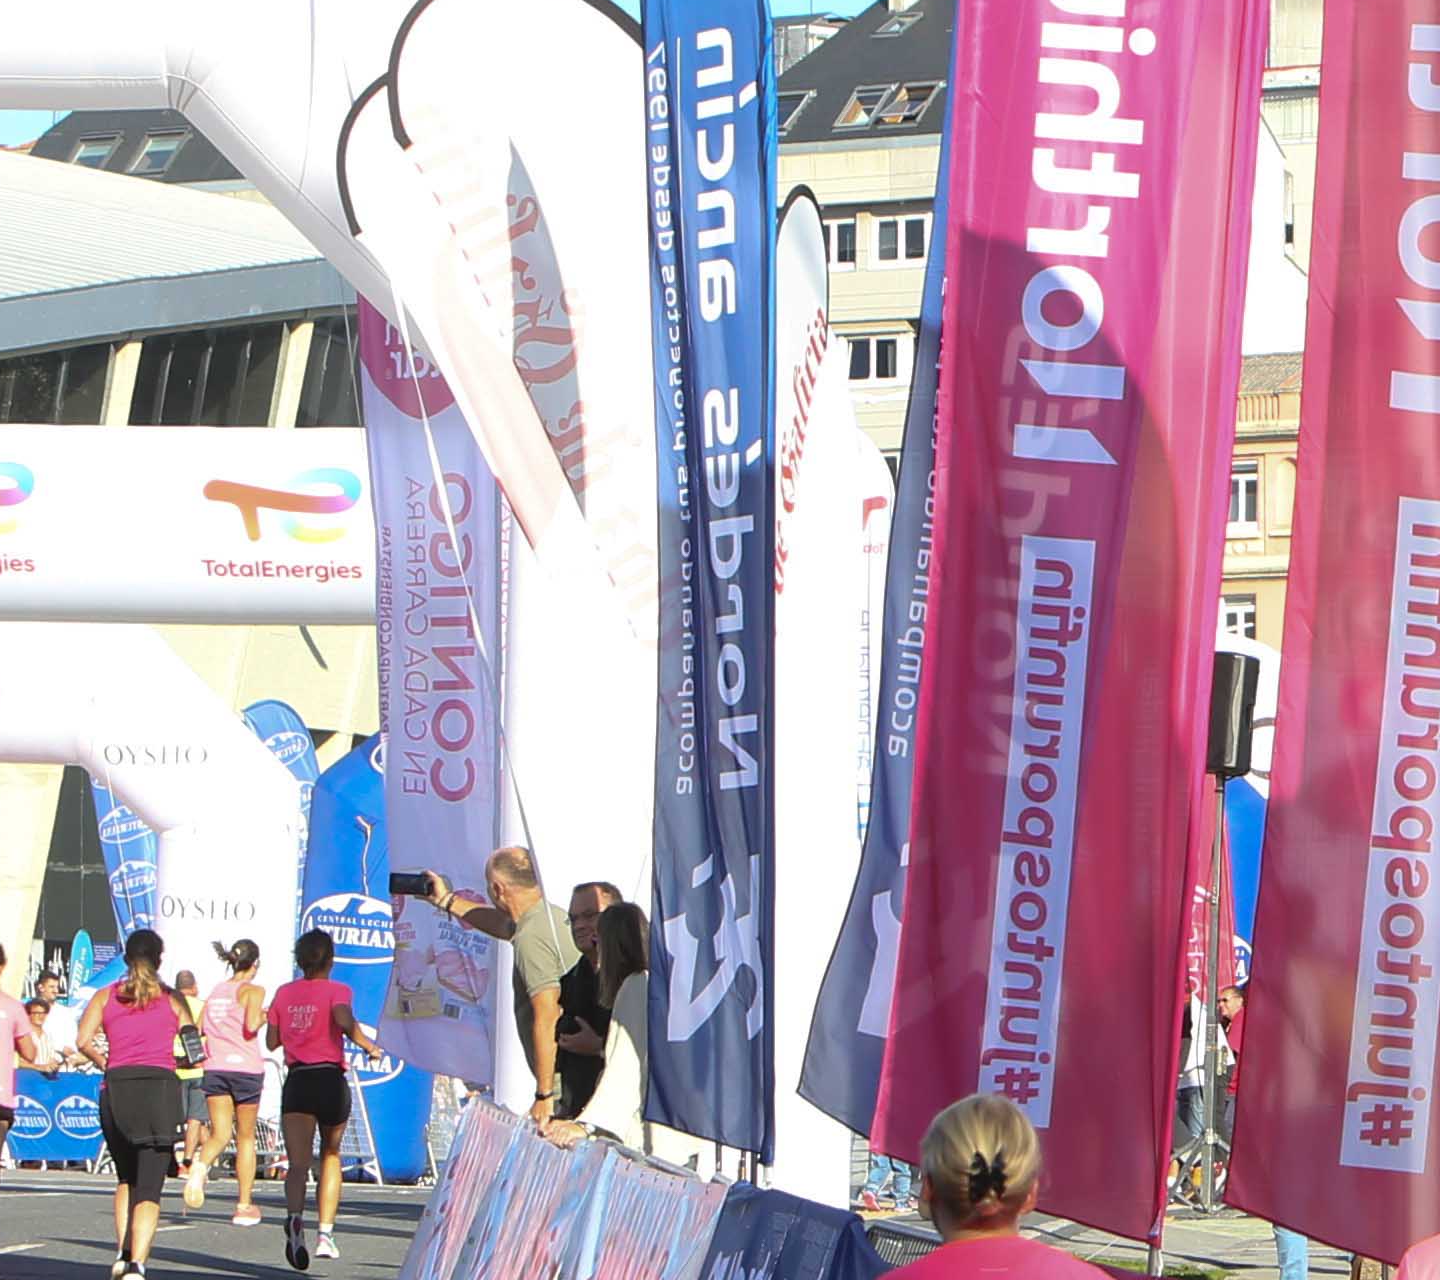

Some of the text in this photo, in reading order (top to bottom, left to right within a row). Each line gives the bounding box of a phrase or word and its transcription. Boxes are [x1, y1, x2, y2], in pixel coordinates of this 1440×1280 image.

[200, 555, 363, 582] TotalEnergies
[103, 744, 209, 766] OYSHO
[160, 895, 256, 920] OYSHO
